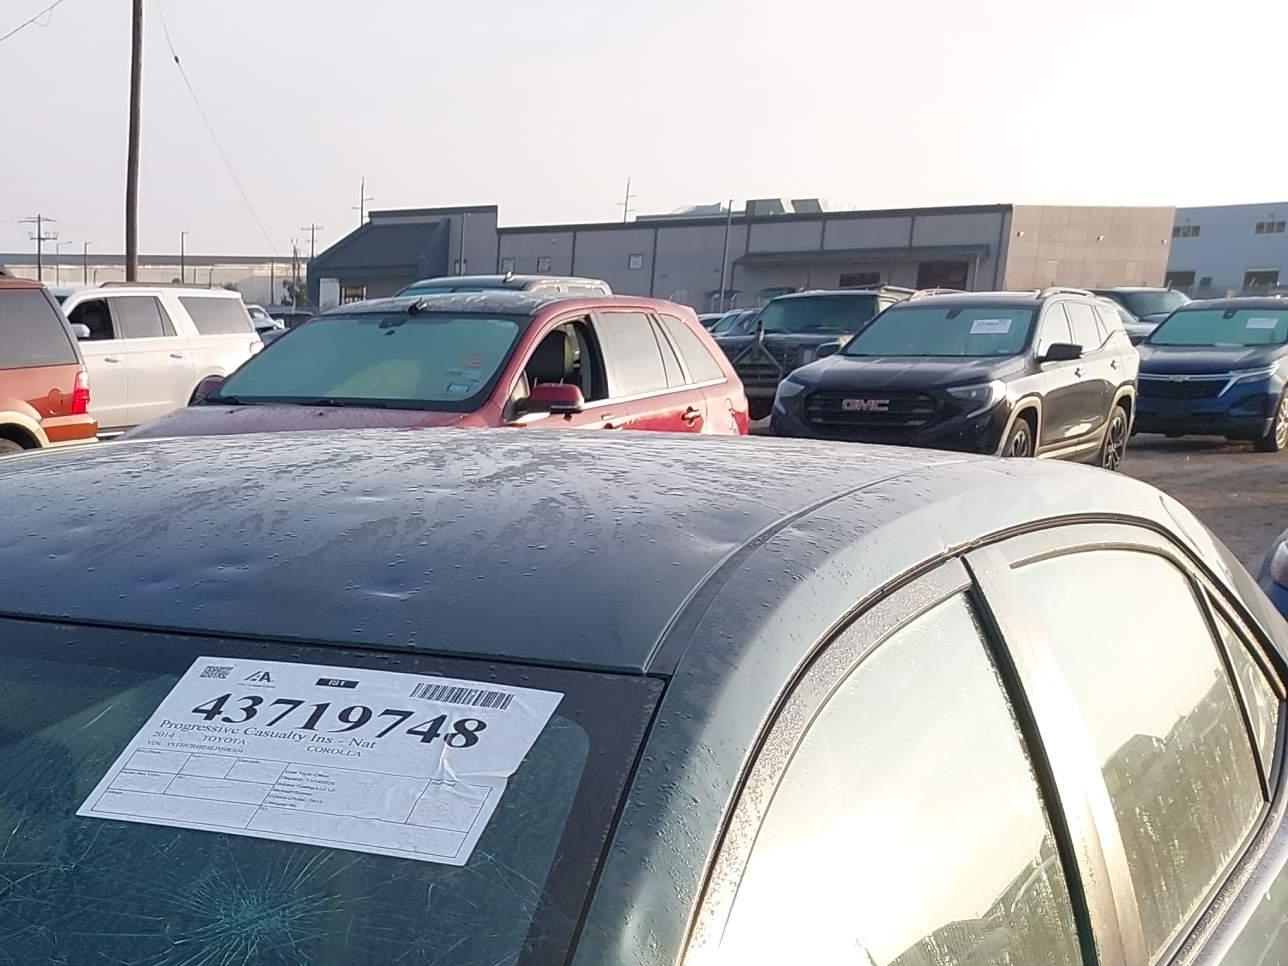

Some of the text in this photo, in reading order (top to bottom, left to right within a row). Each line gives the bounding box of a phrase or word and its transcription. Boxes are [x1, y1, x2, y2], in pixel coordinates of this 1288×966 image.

[841, 399, 889, 412] GMC
[191, 693, 488, 749] 43719748
[152, 731, 175, 739] 2014
[160, 719, 240, 734] Progressive
[244, 727, 308, 743] Casualty
[311, 733, 333, 744] Ins
[348, 737, 377, 749] Nat
[201, 734, 246, 745] TOYOTA
[306, 746, 362, 757] COROLLA
